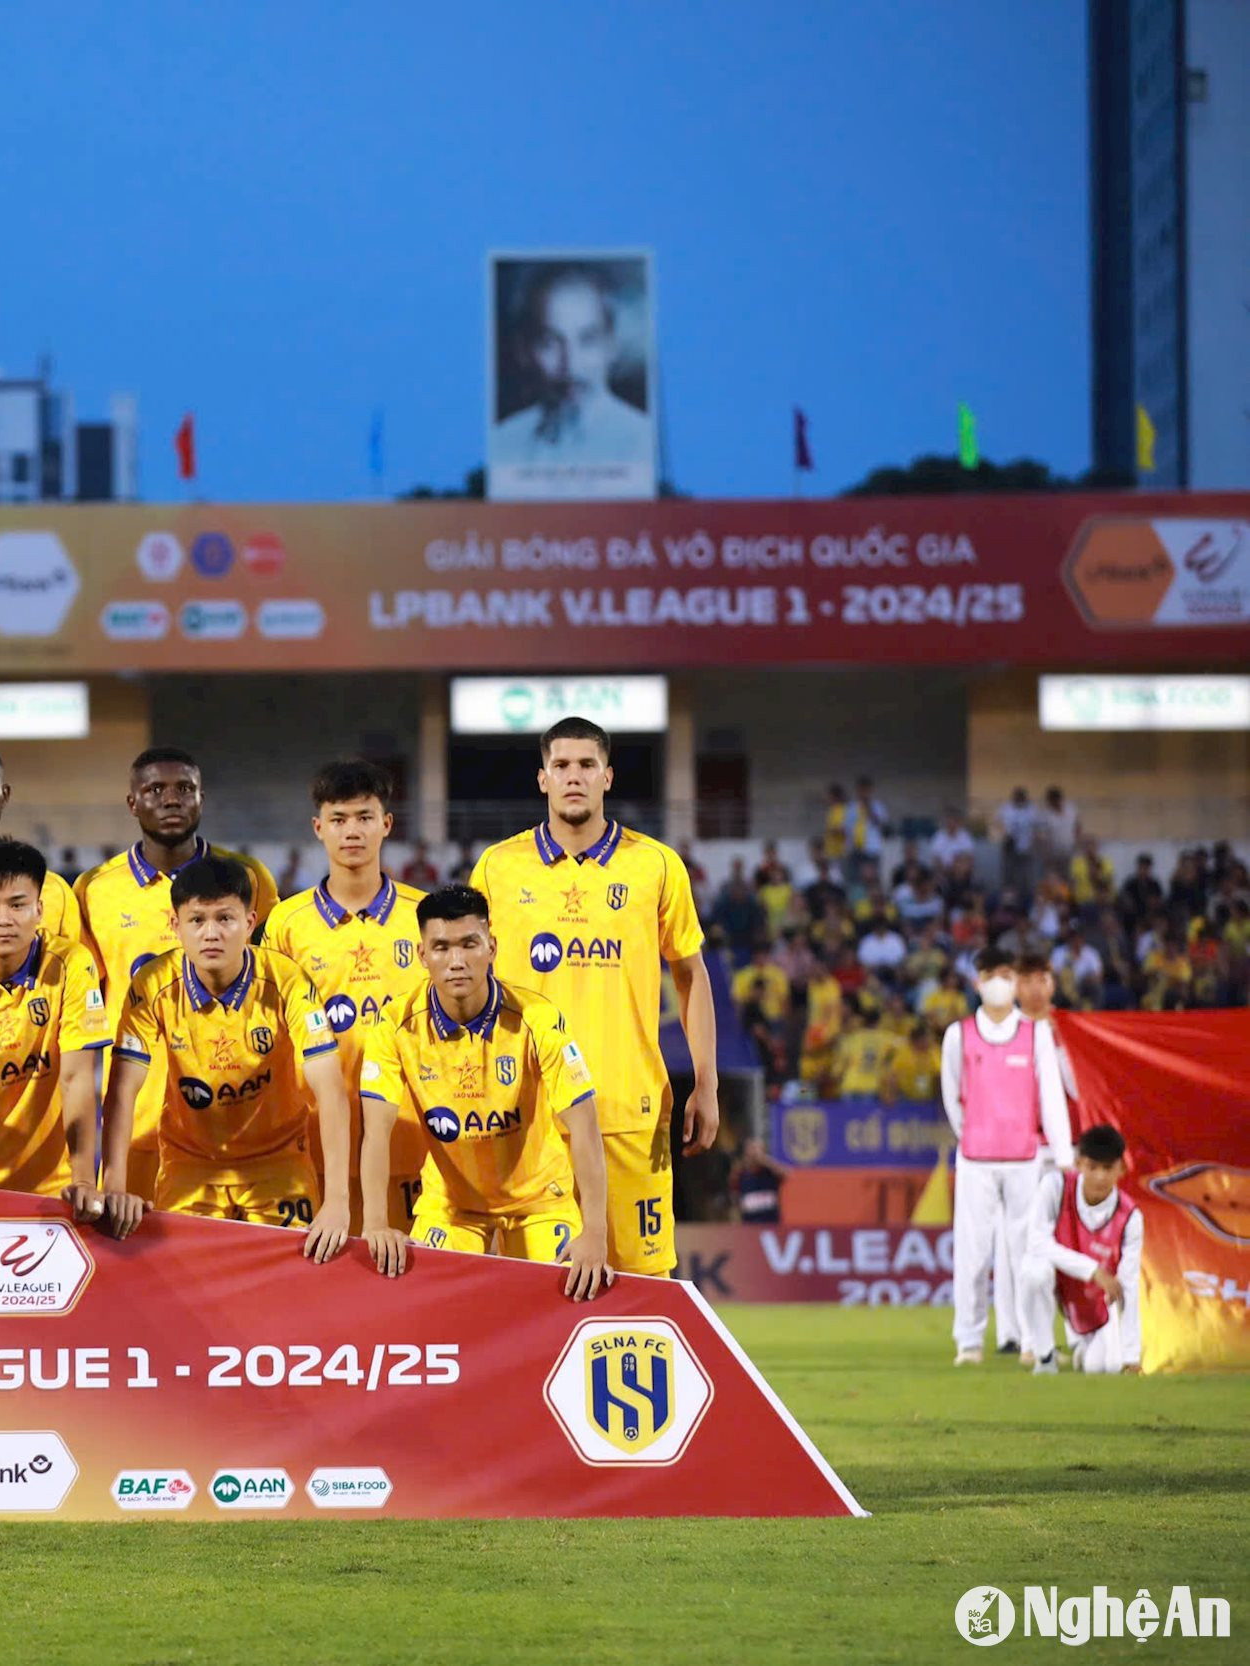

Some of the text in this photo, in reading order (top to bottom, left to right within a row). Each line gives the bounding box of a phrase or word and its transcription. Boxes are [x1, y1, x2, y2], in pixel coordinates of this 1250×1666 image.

[663, 529, 716, 569] VÔ
[916, 533, 979, 567] GIA
[368, 589, 552, 630] LPBANK
[560, 586, 777, 627] V.LEAGUE
[785, 586, 811, 626] 1
[842, 583, 1025, 628] 2024/25
[566, 937, 622, 960] AAN
[217, 1068, 271, 1100] AAN
[465, 1106, 522, 1132] AAN
[635, 1197, 662, 1238] 15
[57, 1282, 62, 1292] 1
[1, 1295, 56, 1306] 2024/25
[591, 1336, 666, 1354] SLNA FC
[127, 1347, 158, 1389] 1
[207, 1344, 460, 1391] 2024/25
[118, 1478, 168, 1494] BAF
[244, 1478, 285, 1493] AAN
[332, 1481, 387, 1490] SIBA FOOD
